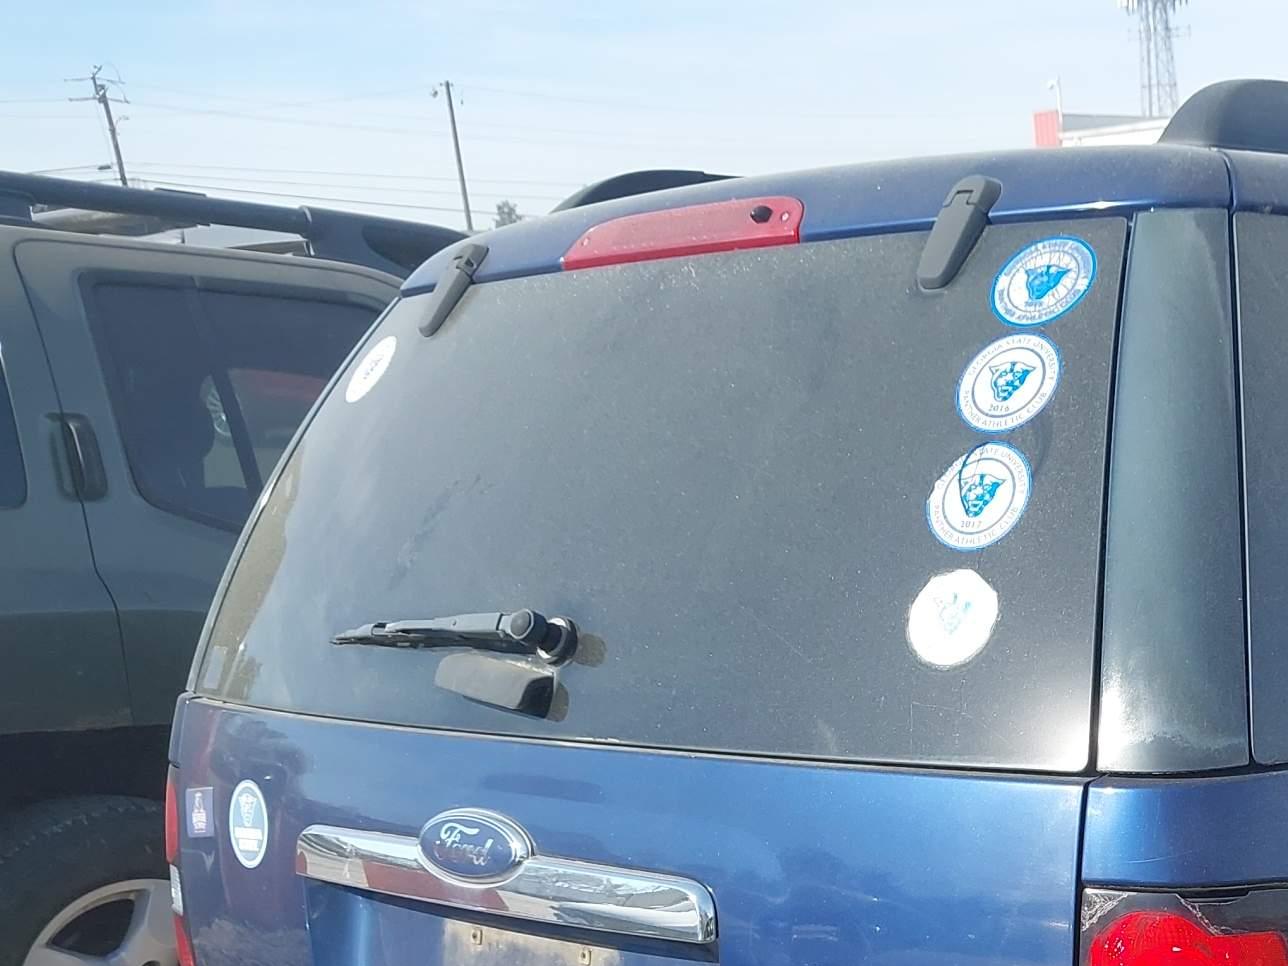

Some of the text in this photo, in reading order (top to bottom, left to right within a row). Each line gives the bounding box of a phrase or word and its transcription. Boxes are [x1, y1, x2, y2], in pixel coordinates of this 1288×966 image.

[967, 337, 1056, 380] GEORGIA STATE UNIVERSITY
[982, 415, 1023, 428] ATHLETIC
[1027, 392, 1047, 414] CLUB
[1001, 450, 1026, 494] UNIVERSITY
[954, 529, 998, 545] ATHLETIC
[999, 506, 1019, 530] CLUB
[961, 520, 982, 528] 2017
[433, 822, 494, 866] Ford
